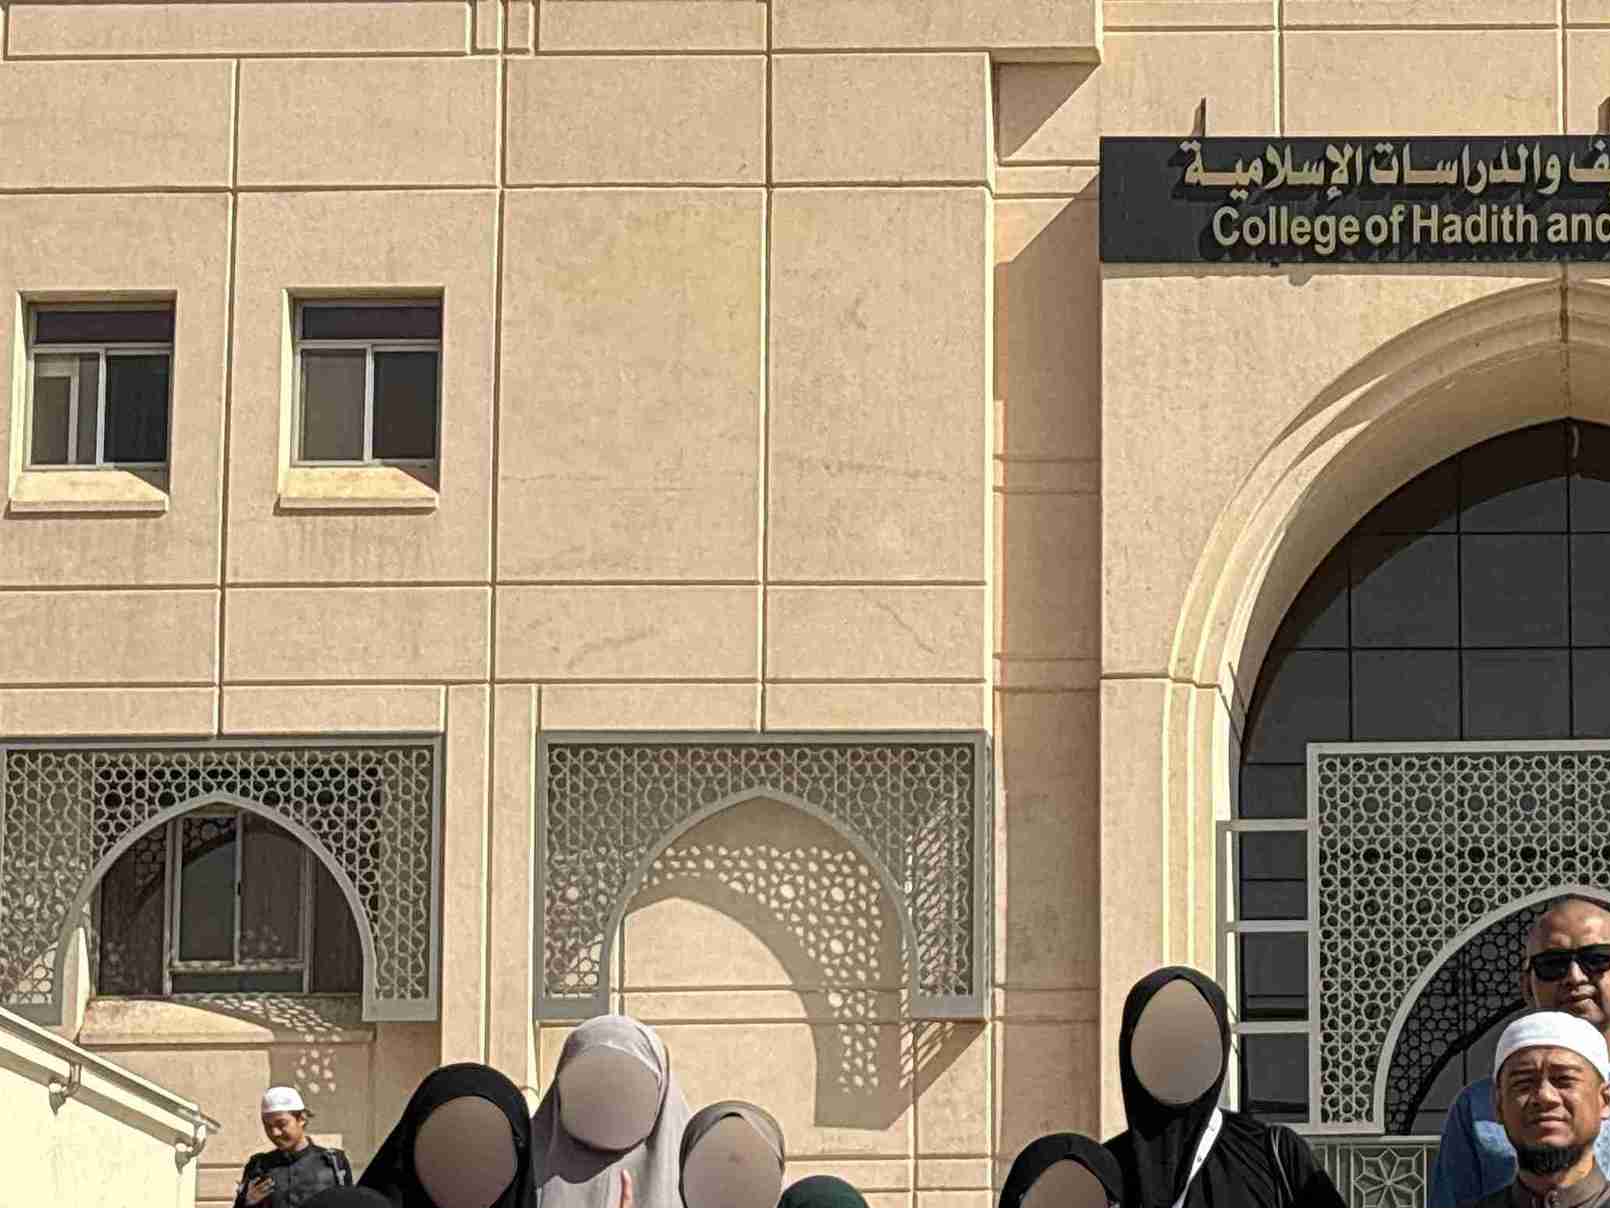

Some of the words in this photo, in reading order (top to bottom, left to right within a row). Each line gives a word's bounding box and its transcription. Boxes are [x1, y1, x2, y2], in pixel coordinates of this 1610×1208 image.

[1369, 141, 1562, 195] والدراسات
[1212, 205, 1361, 256] College
[1364, 204, 1406, 245] of
[1412, 204, 1539, 245] Hadith
